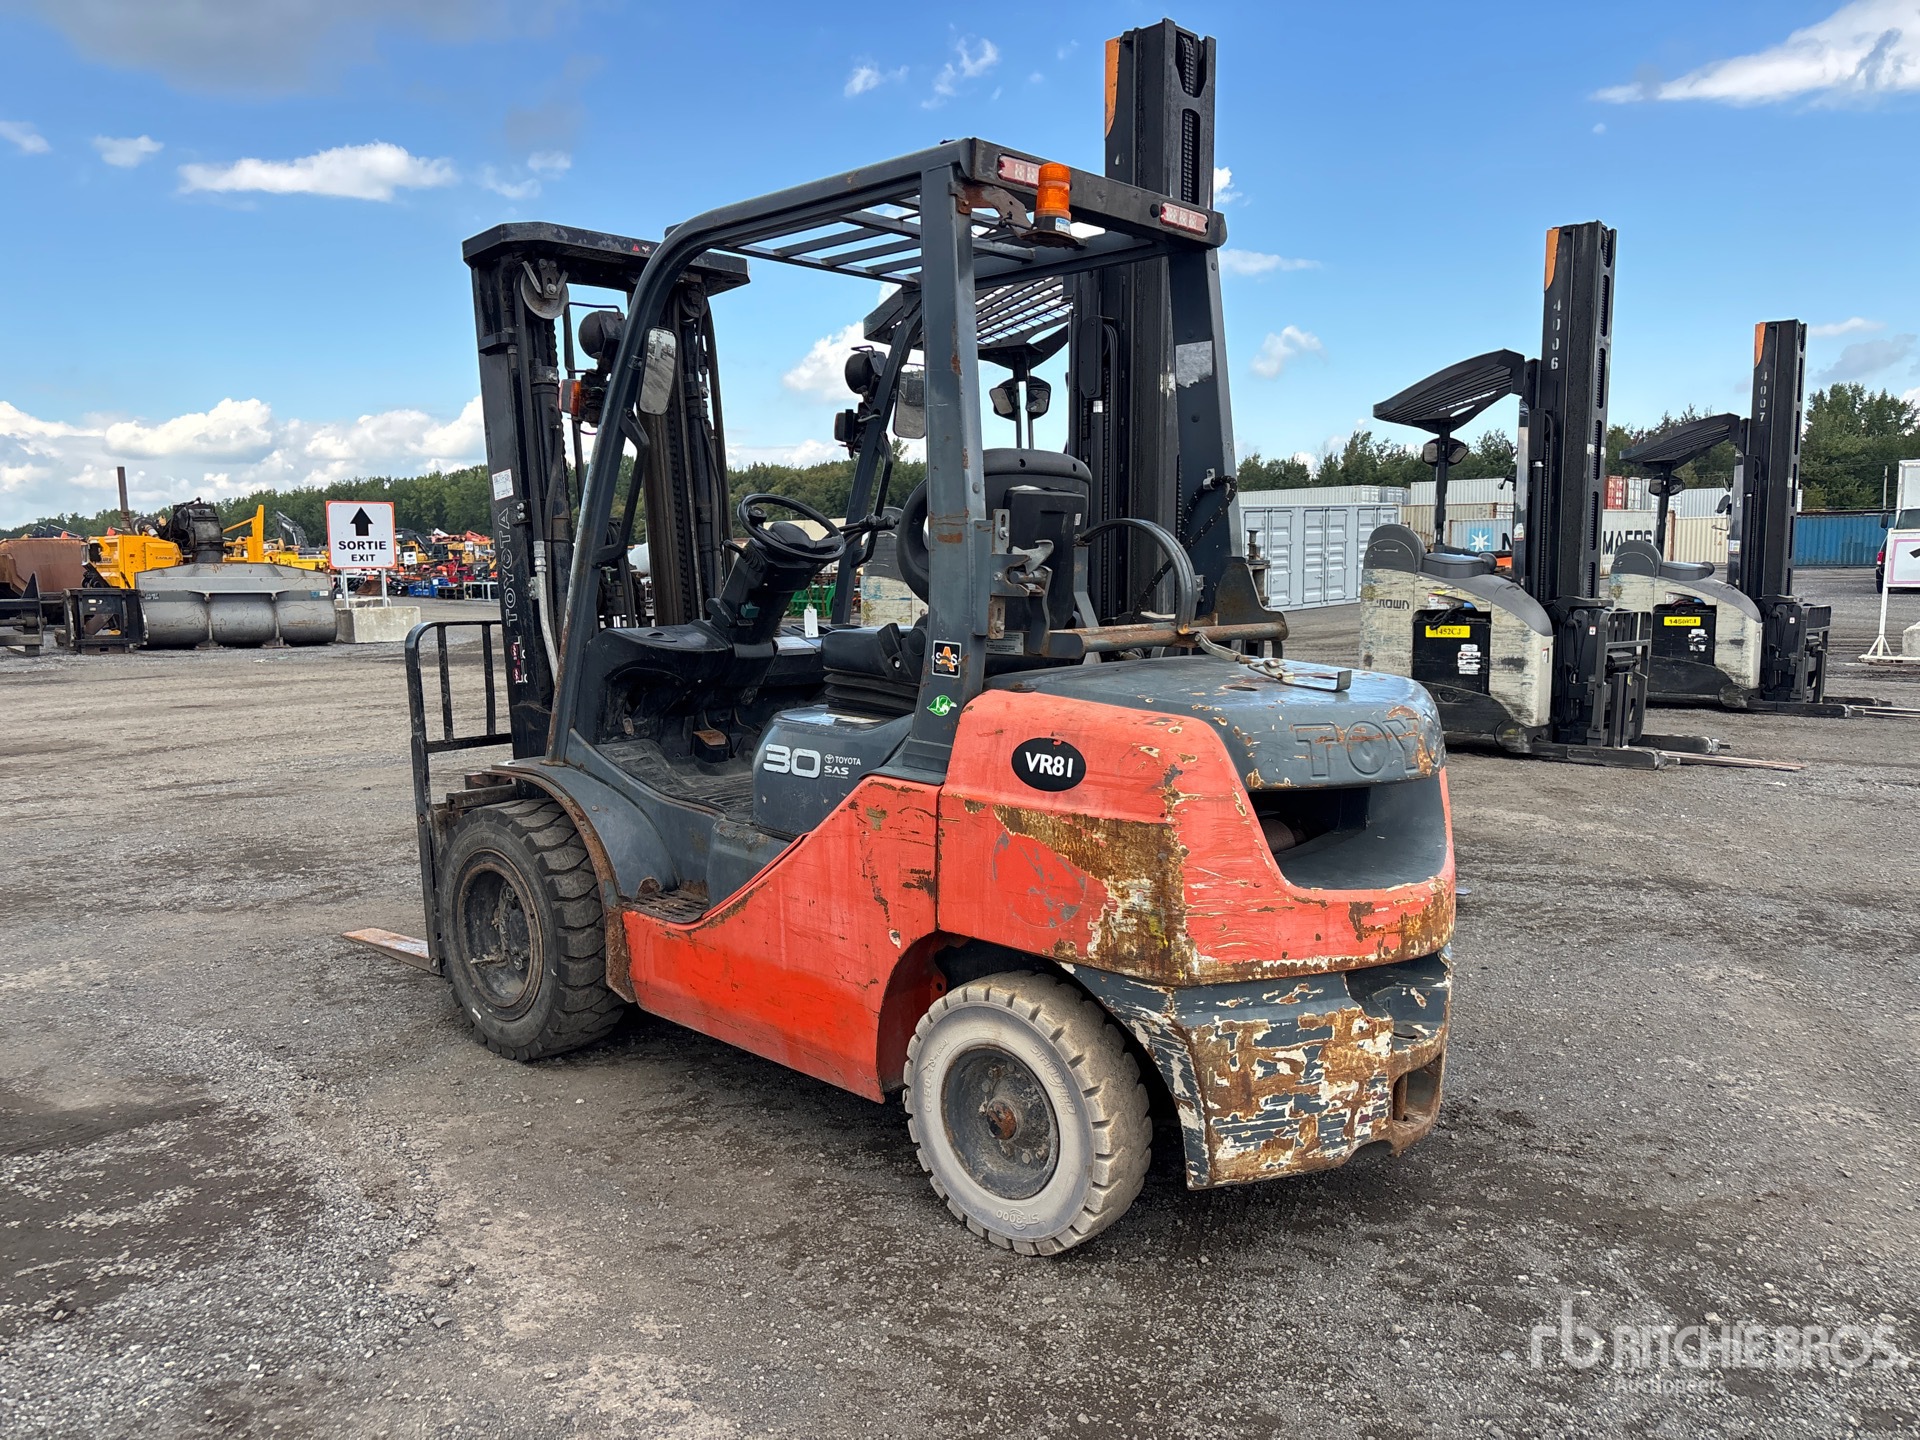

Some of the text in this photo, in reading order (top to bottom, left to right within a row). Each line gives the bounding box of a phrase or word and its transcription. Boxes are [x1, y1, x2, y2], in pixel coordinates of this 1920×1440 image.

[338, 540, 387, 550] SORTIE
[351, 554, 376, 562] EXIT
[498, 507, 518, 627] TOYOTA
[763, 743, 821, 779] 30
[834, 755, 862, 766] TOYOTA
[823, 765, 850, 776] SAS
